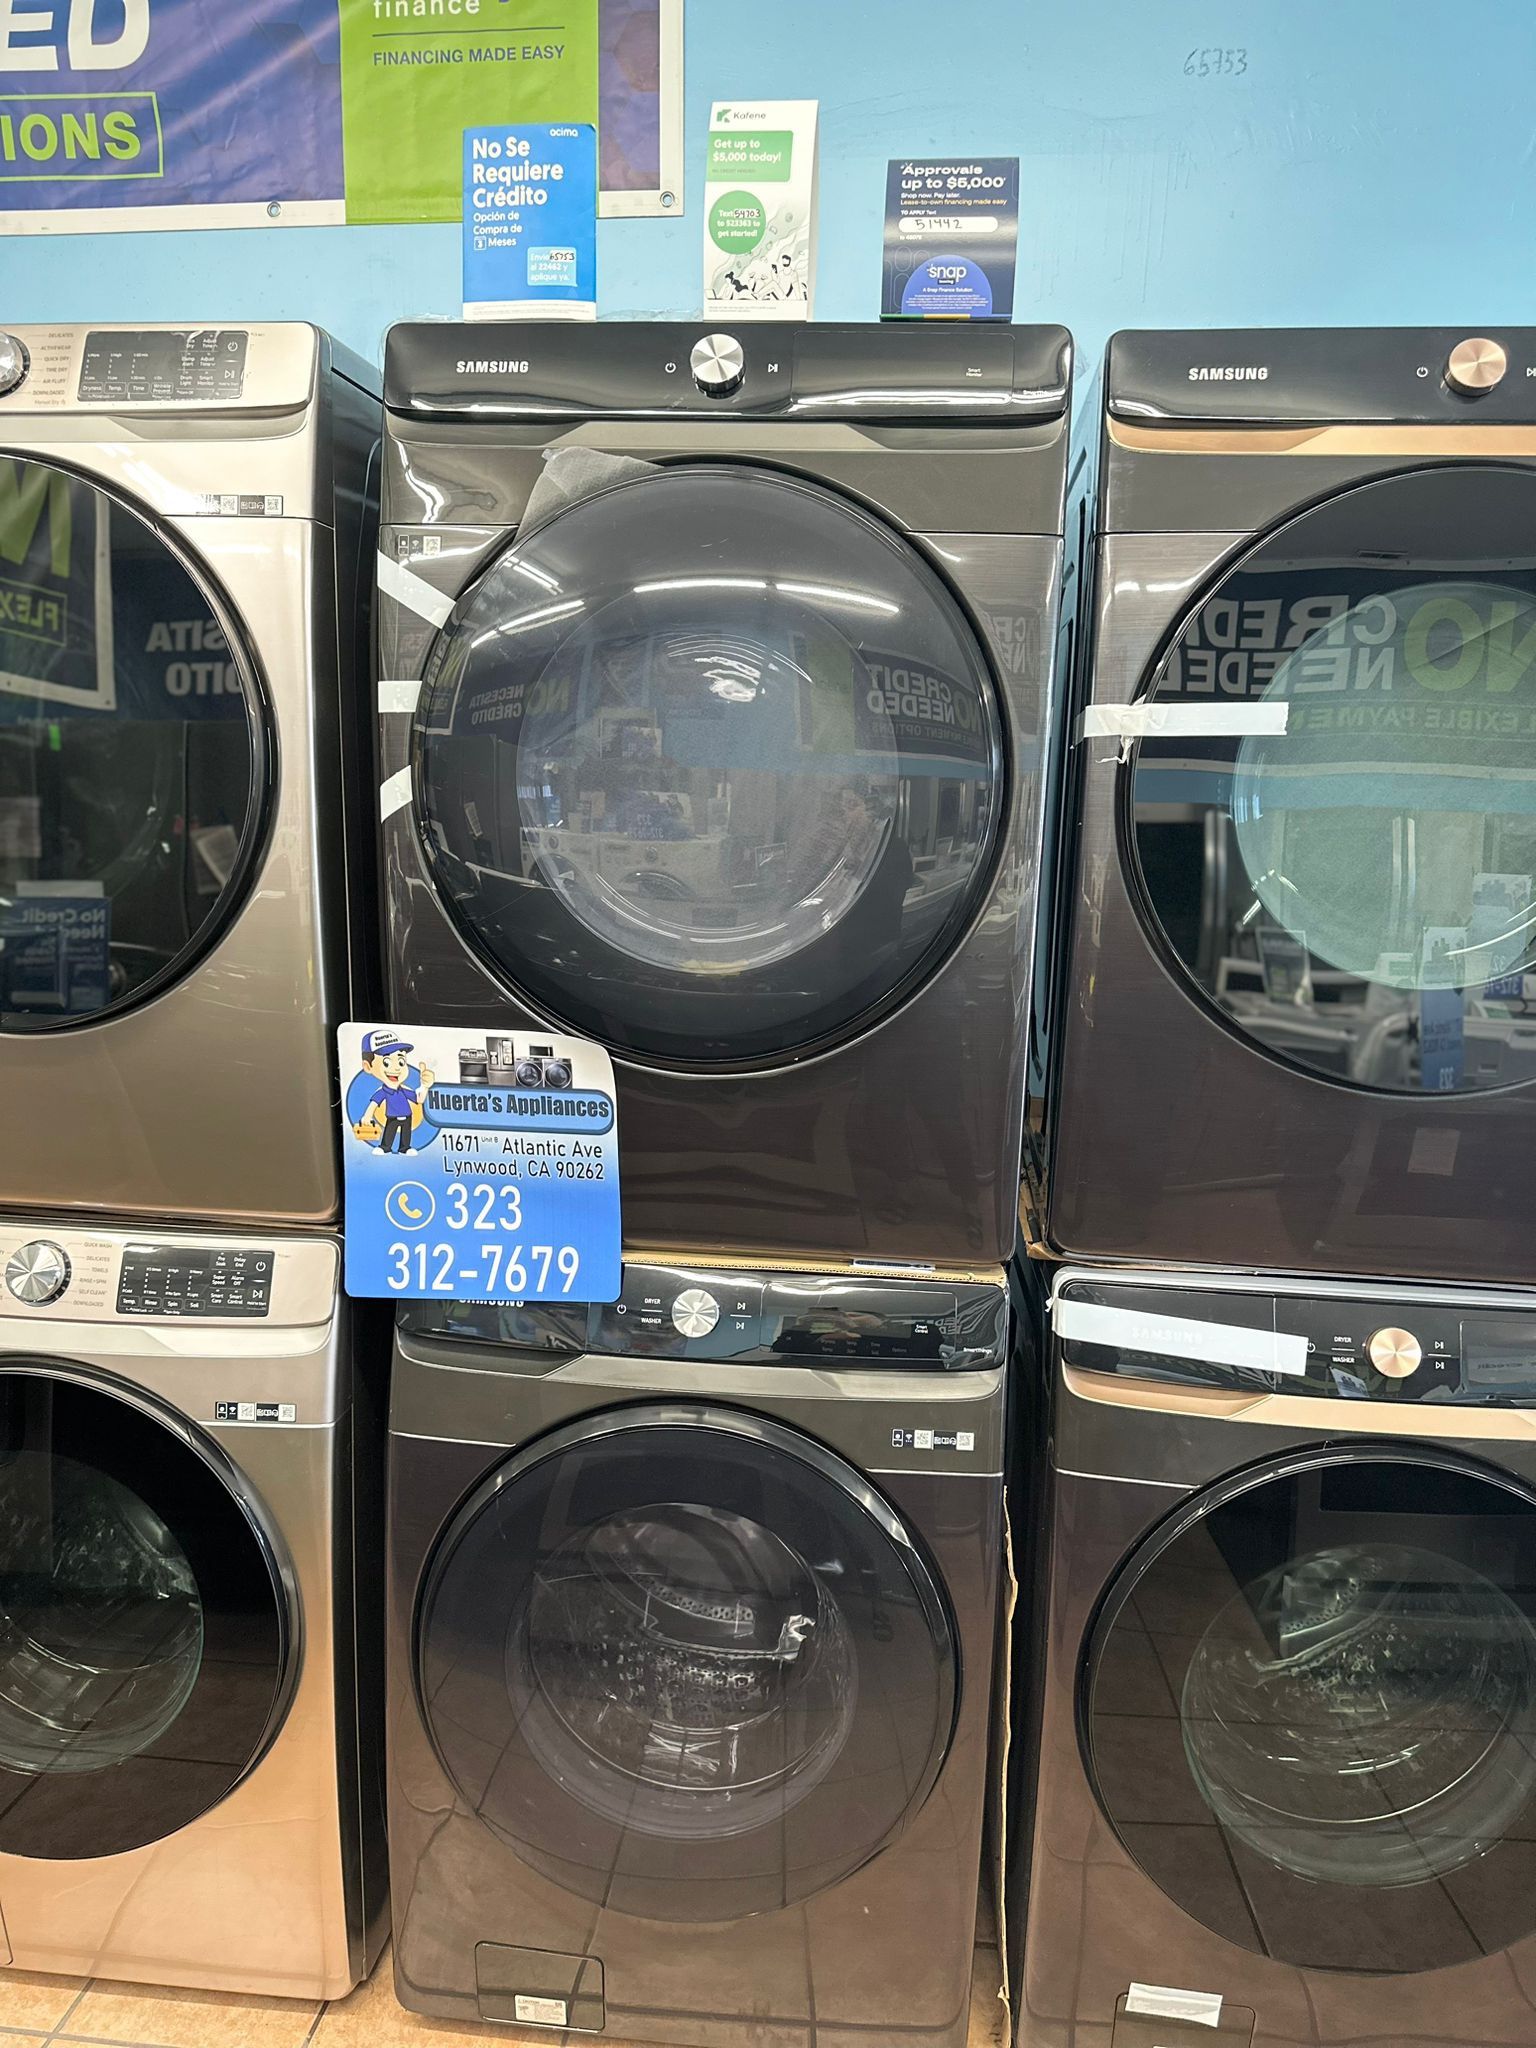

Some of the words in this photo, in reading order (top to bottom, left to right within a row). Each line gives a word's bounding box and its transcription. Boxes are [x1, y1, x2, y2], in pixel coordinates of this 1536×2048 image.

[373, 0, 480, 18] finance
[373, 49, 463, 66] FINANCING
[468, 47, 517, 62] MADE
[521, 45, 565, 60] EASY
[549, 128, 578, 137] acima
[472, 138, 502, 160] No
[505, 136, 531, 157] Se
[714, 139, 732, 148] Get
[734, 141, 747, 150] up
[749, 140, 760, 148] to
[713, 151, 747, 162] $5,000
[749, 151, 782, 164] today!
[473, 160, 563, 187] Requiere
[902, 164, 983, 177] Approvals
[902, 179, 922, 191] up
[926, 178, 943, 189] to
[473, 184, 548, 208] Crédito
[473, 211, 506, 223] Opción
[507, 211, 519, 220] de
[915, 219, 963, 230] 51442
[473, 225, 508, 236] Compra
[510, 224, 522, 233] de
[718, 230, 730, 238] get
[488, 238, 517, 247] Meses
[928, 265, 967, 282] snap
[456, 360, 530, 373] SAMSUNG
[1188, 366, 1268, 381] SAMSUNG
[429, 1090, 501, 1114] Huerta’s
[506, 1094, 609, 1118] Appliances
[442, 1134, 479, 1152] 11671
[502, 1137, 566, 1156] Atlantic
[572, 1141, 602, 1158] Ave
[444, 1156, 522, 1178] Lynwood,
[528, 1160, 550, 1177] CA
[556, 1162, 604, 1180] 90262
[445, 1183, 522, 1231] 323
[387, 1242, 580, 1293] 312-7679
